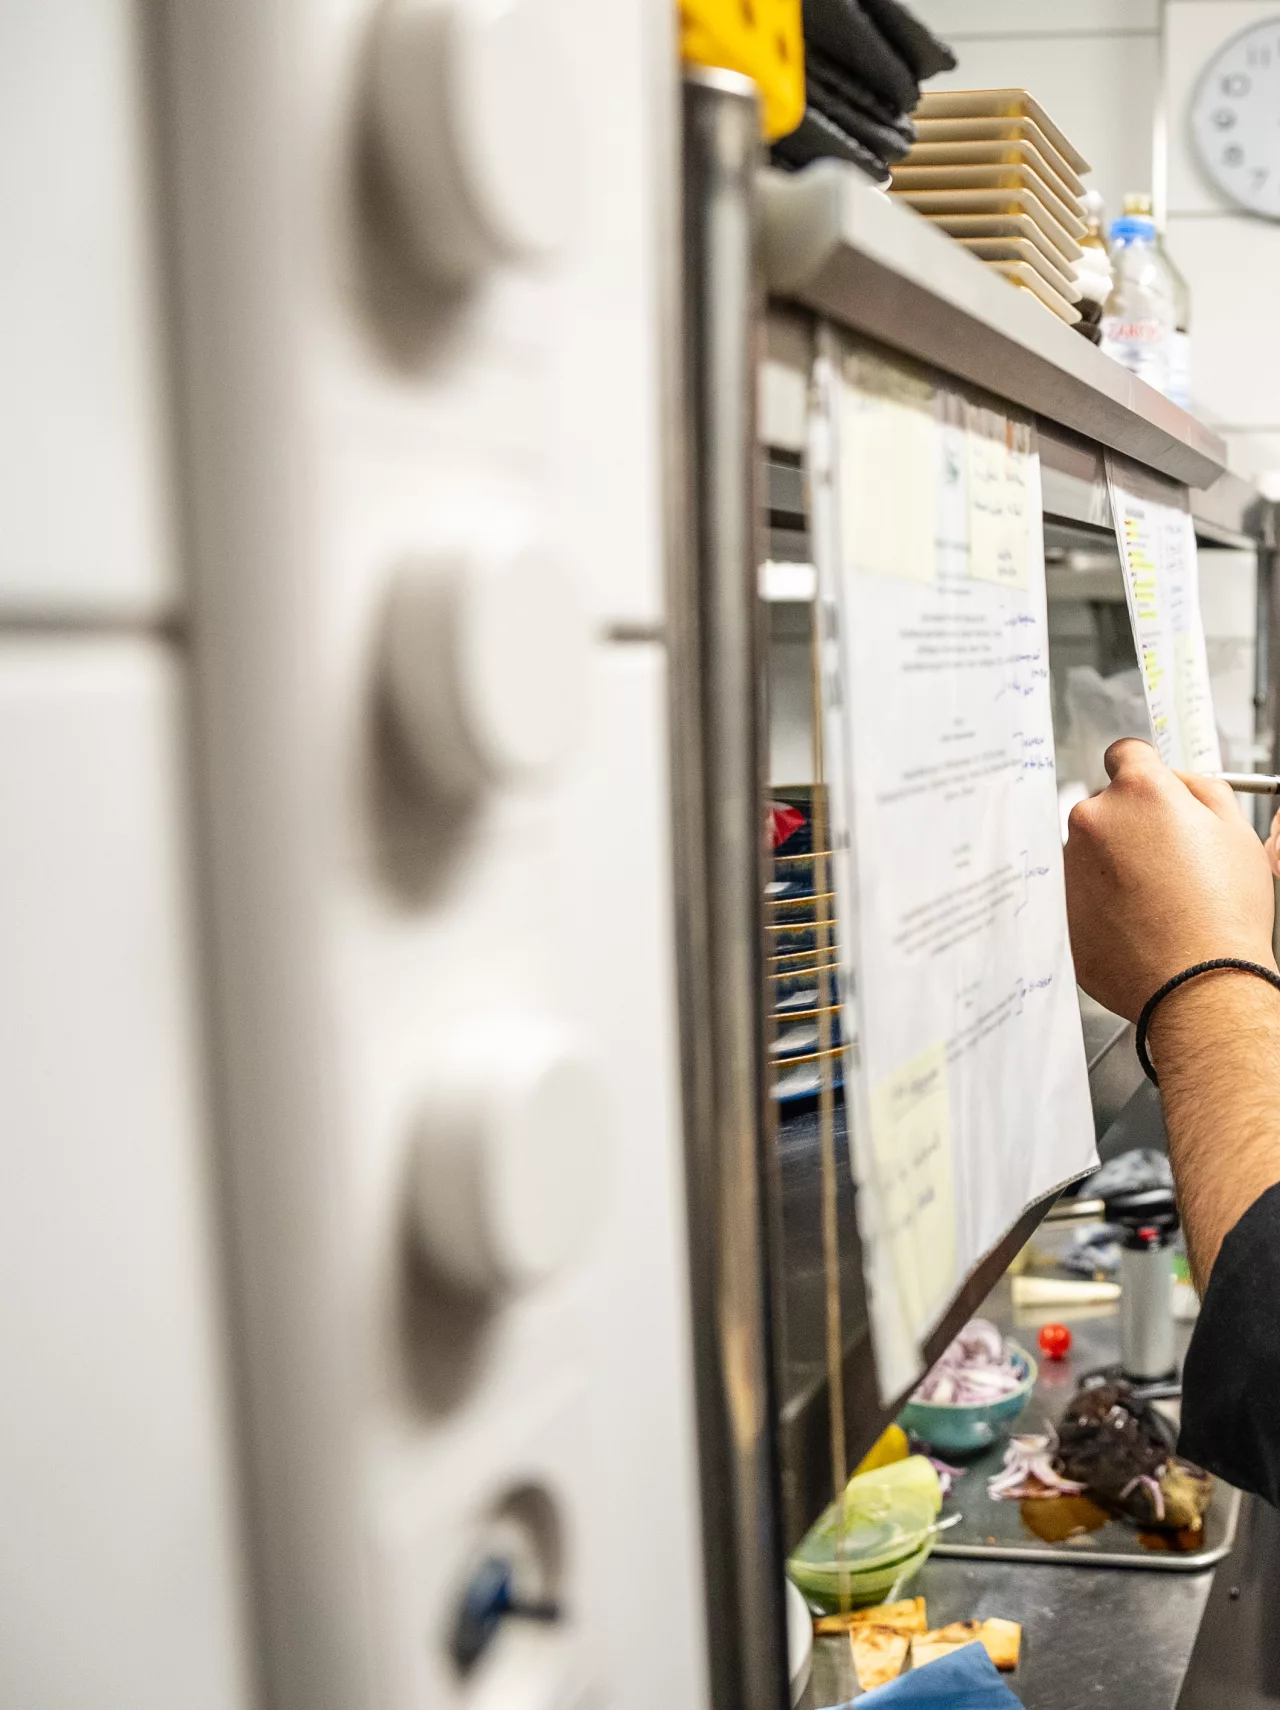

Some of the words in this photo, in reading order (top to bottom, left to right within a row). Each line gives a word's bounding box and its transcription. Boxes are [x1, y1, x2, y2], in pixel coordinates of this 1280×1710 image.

[1246, 43, 1271, 69] 11
[1218, 71, 1252, 98] 10
[1210, 106, 1238, 132] 9
[1221, 140, 1245, 169] 8
[1250, 167, 1270, 191] 7
